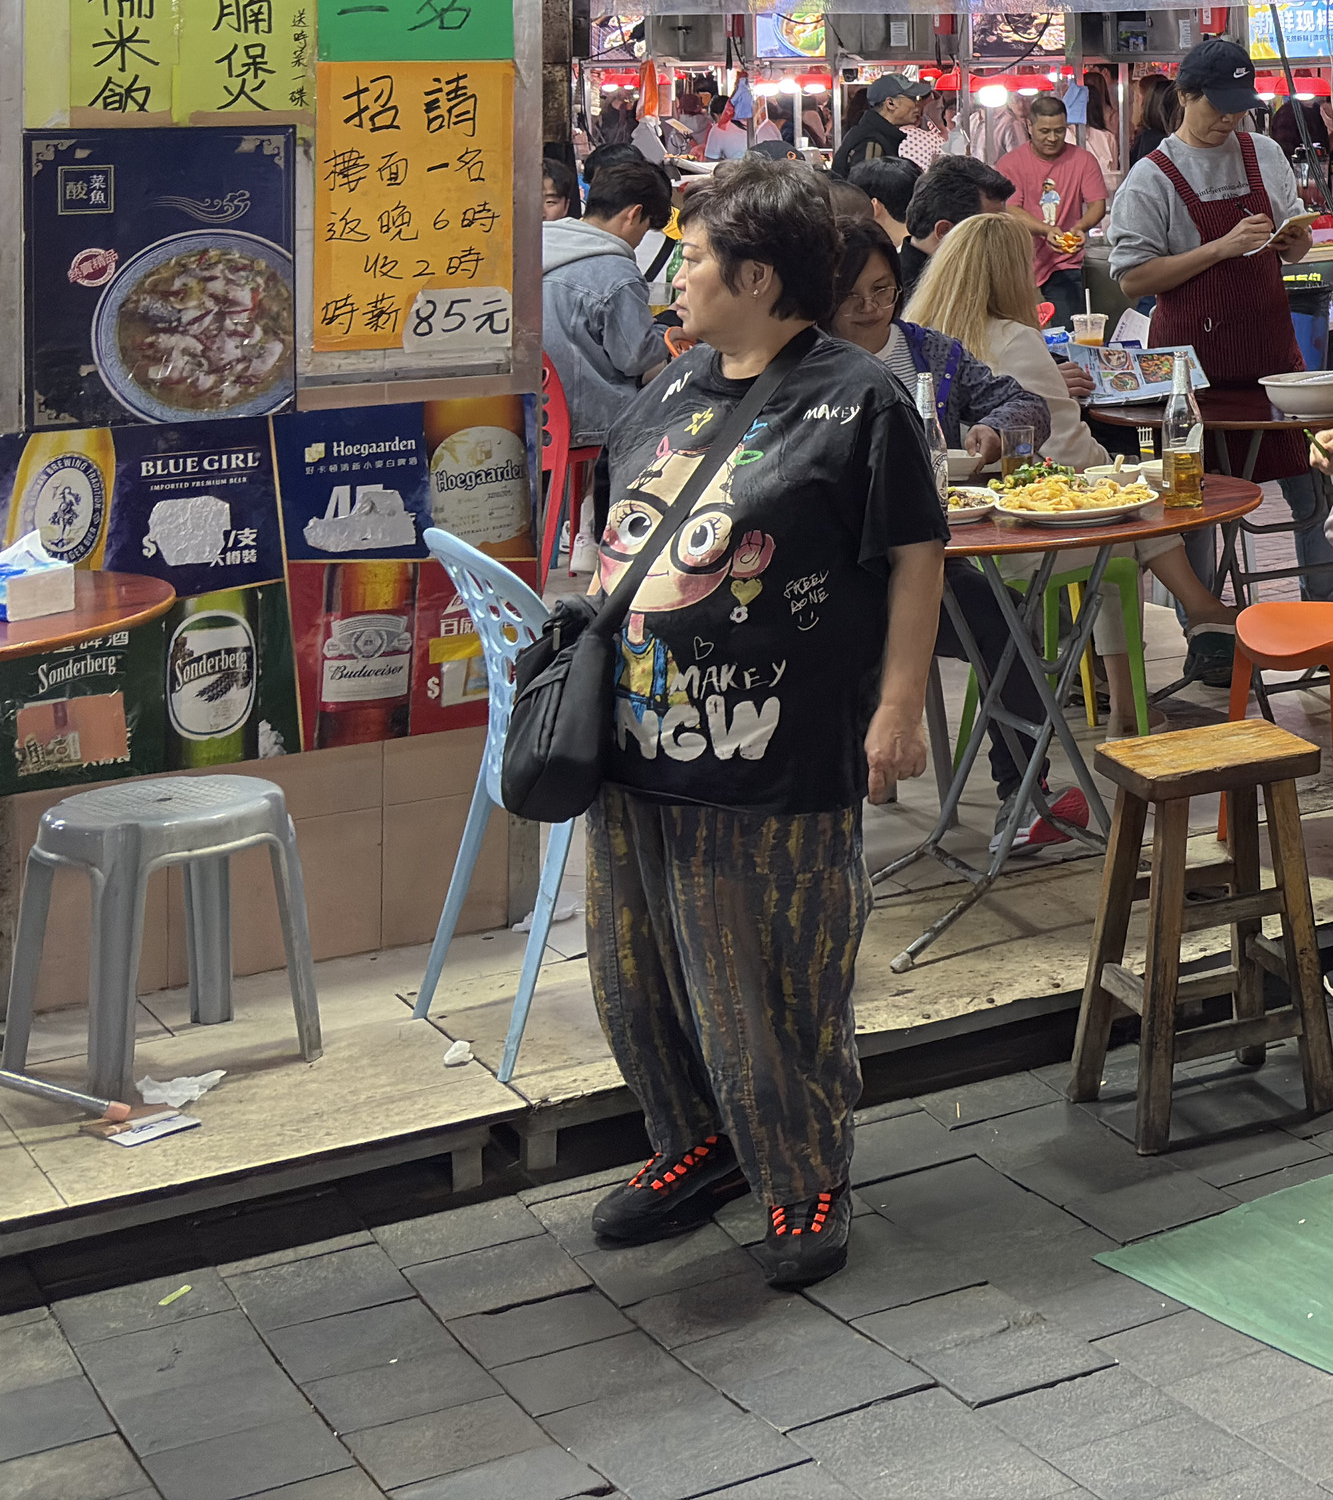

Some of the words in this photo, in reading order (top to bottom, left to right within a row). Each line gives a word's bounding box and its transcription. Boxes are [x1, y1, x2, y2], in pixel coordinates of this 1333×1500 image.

[342, 72, 478, 138] 招請
[803, 403, 861, 424] MAKEY
[333, 436, 416, 457] Hoegaarden
[45, 456, 87, 477] BREWING
[85, 464, 103, 509] TRADITION
[141, 456, 199, 478] BLUE
[203, 452, 260, 472] GIRL
[435, 460, 526, 493] Hoegaarden
[150, 481, 190, 491] IMPORTED
[38, 654, 117, 694] Sonderberg
[174, 650, 248, 690] Sonderberg
[668, 659, 787, 701] MAKEY
